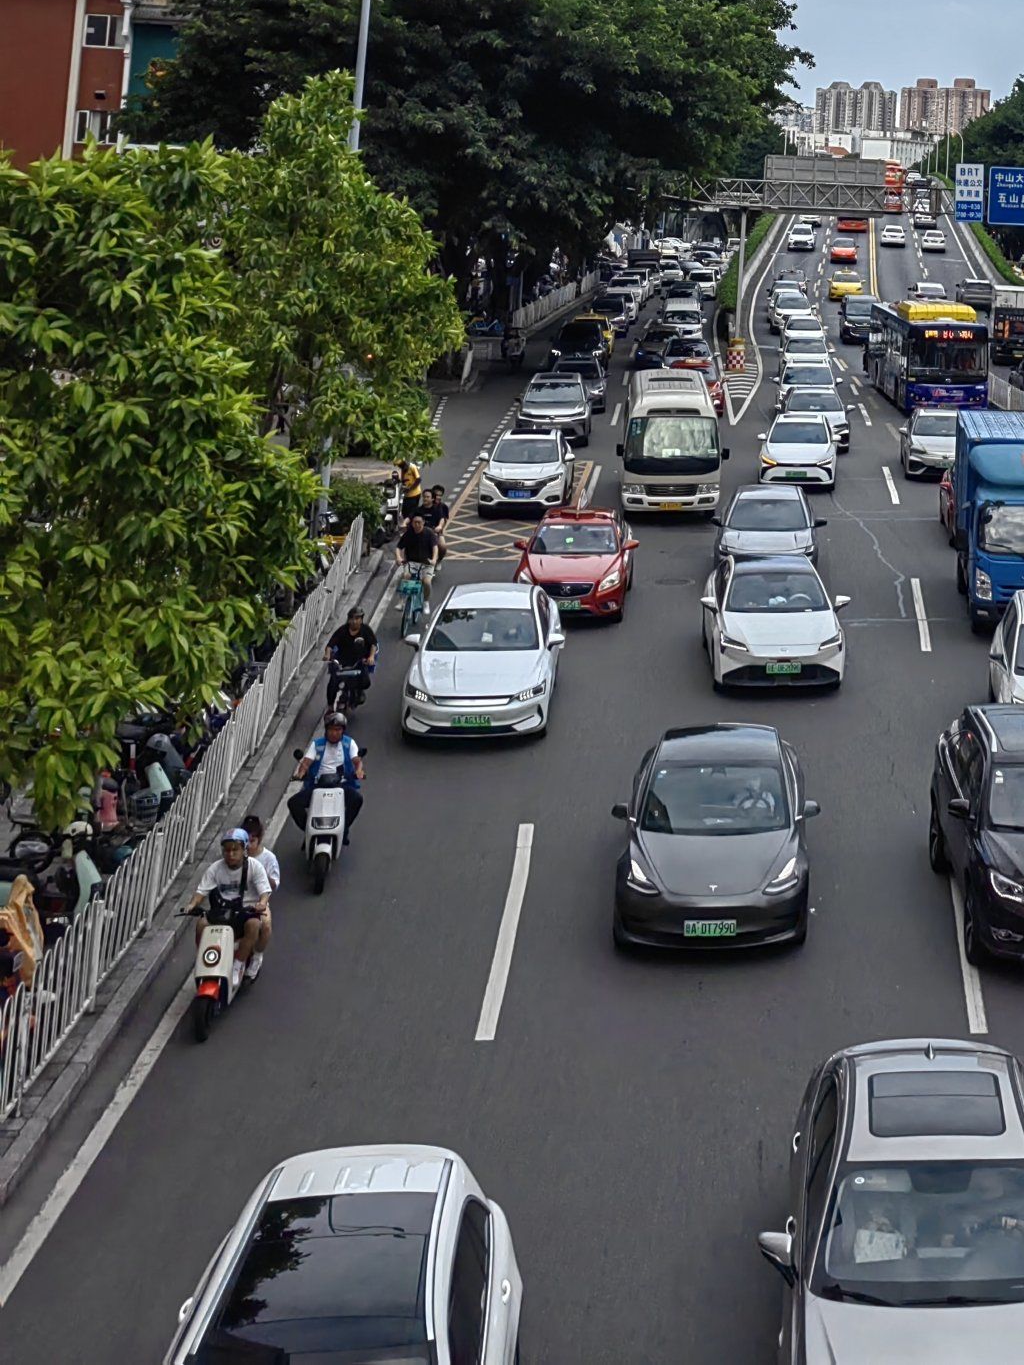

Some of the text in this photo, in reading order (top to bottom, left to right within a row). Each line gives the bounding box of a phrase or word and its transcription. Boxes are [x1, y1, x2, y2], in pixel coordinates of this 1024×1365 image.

[960, 167, 980, 177] BRT
[958, 189, 980, 198] 专用道
